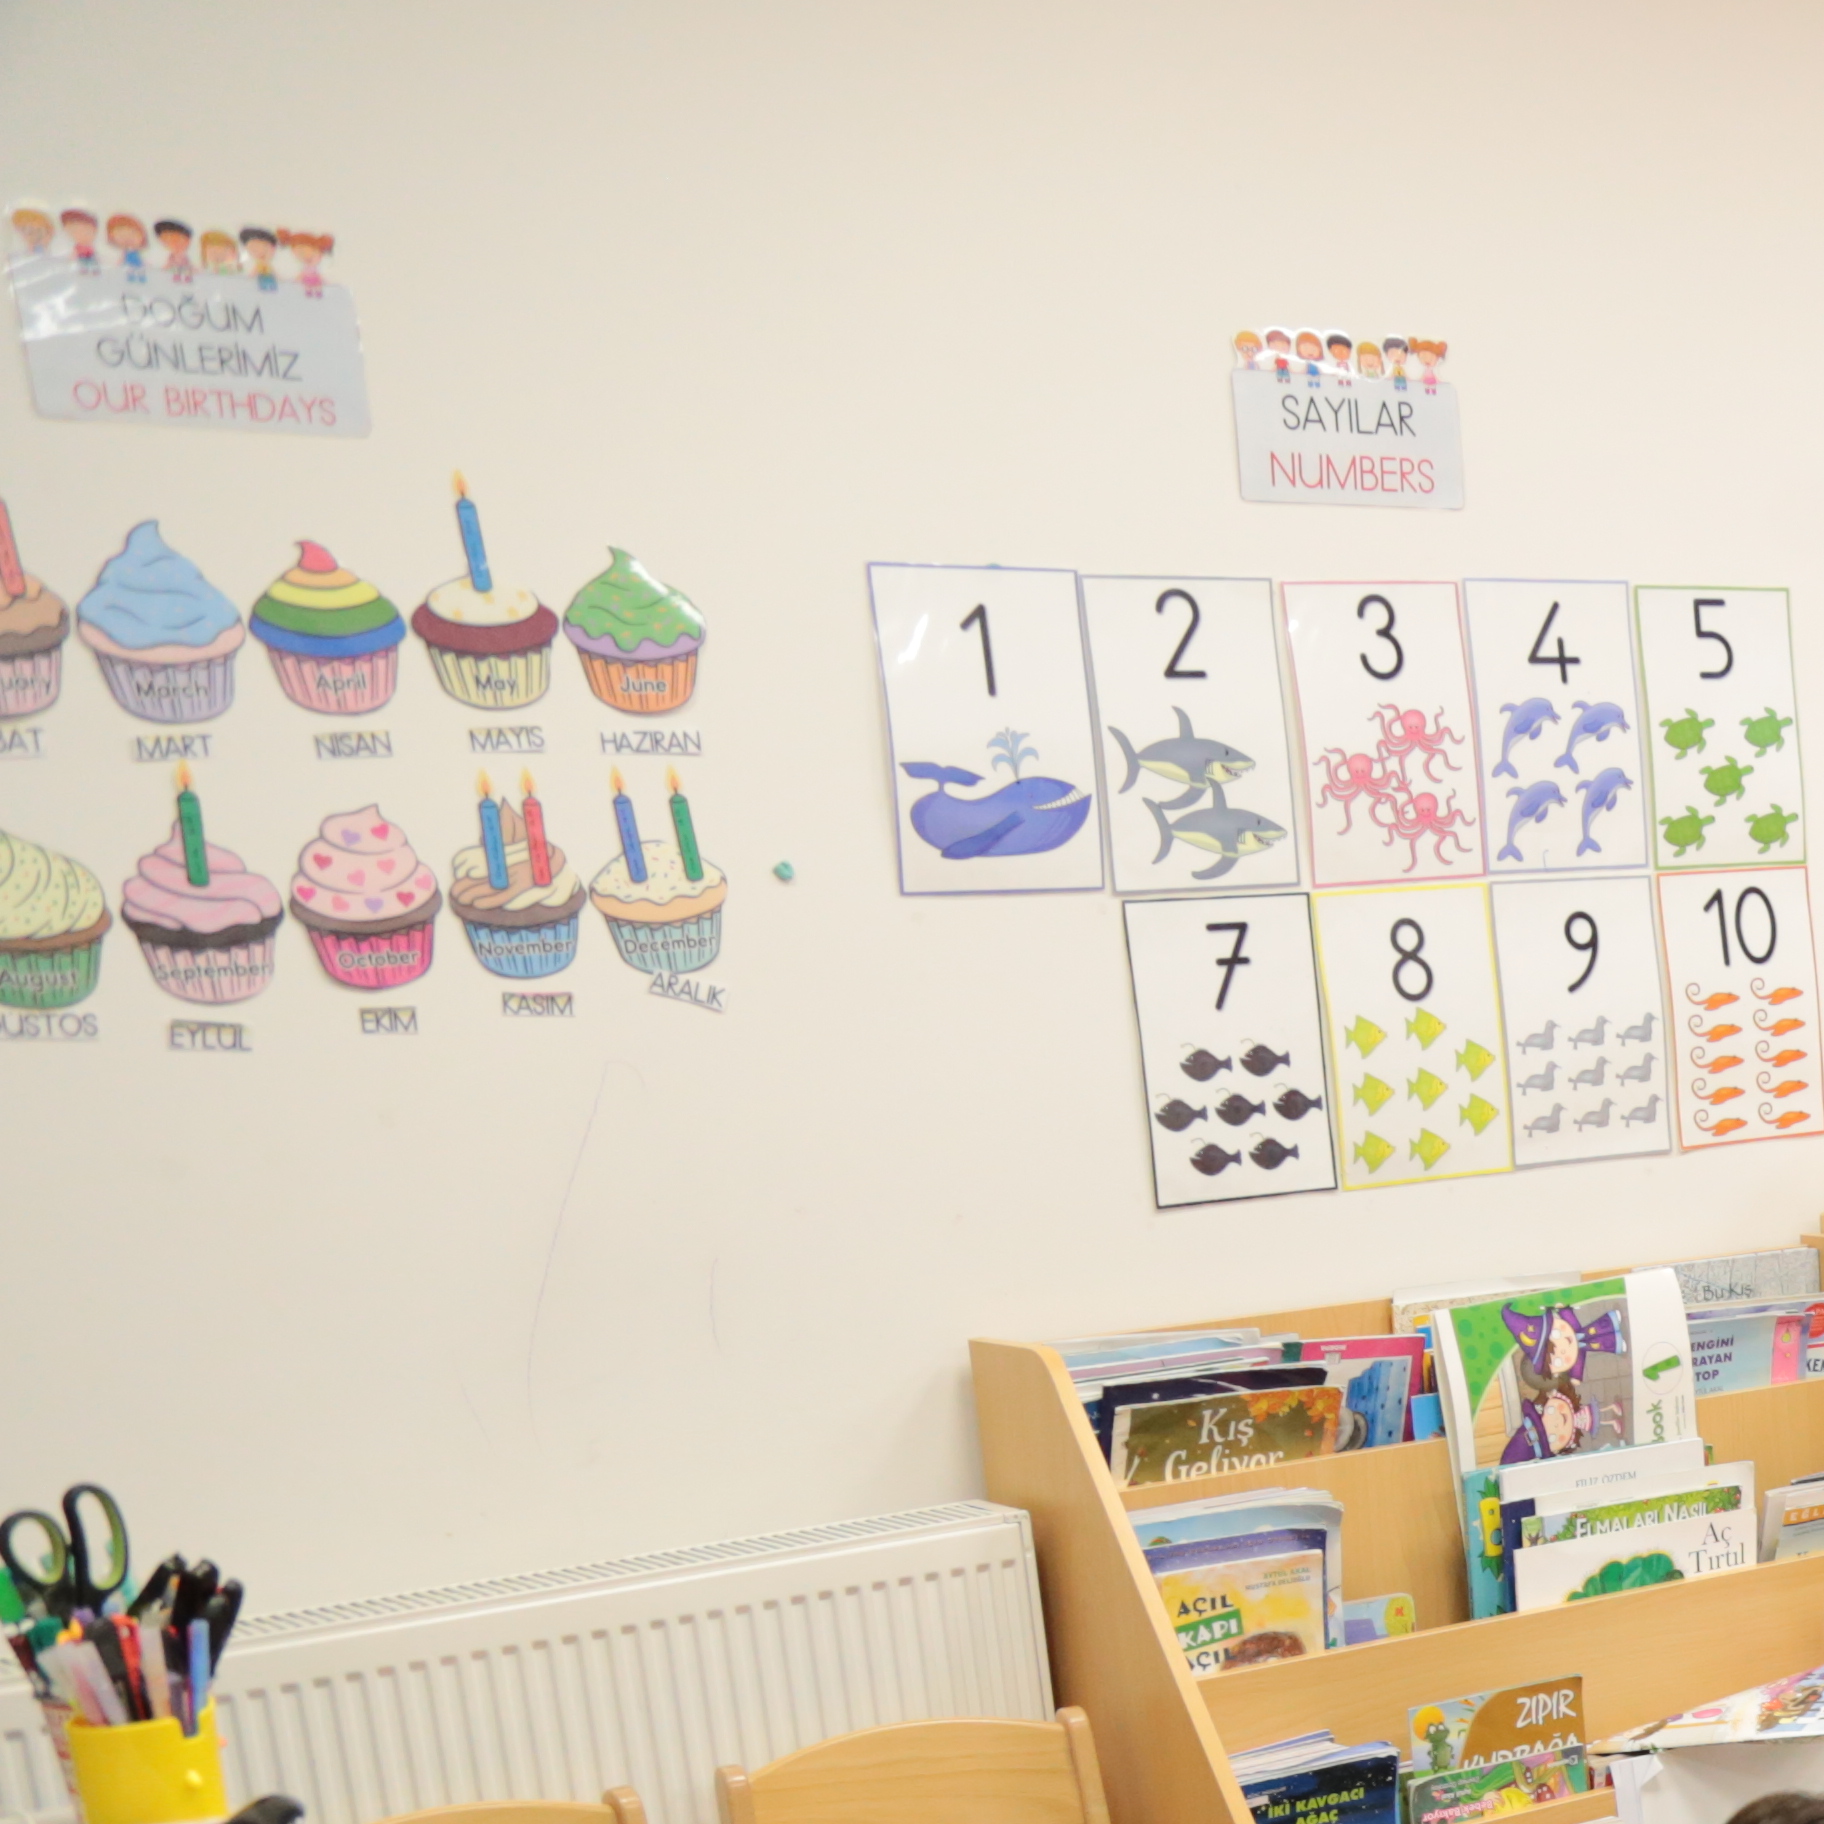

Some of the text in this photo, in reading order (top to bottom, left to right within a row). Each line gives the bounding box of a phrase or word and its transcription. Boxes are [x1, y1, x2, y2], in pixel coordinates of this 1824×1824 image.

[122, 293, 264, 334] DOĞUM
[97, 334, 303, 382] GÜNLERİMİZ
[73, 379, 337, 426] OUR BIRTHDAYS
[1281, 394, 1416, 437] SAYILAR
[1270, 451, 1435, 494] NUMBERS
[1154, 588, 1208, 681] 2
[1356, 594, 1404, 681] 3
[1527, 601, 1581, 685] 4
[1692, 598, 1735, 680] 5
[959, 604, 997, 697] 1
[136, 680, 208, 698] March
[315, 673, 367, 694] April
[475, 674, 516, 693] May
[620, 676, 667, 694] June
[136, 734, 213, 760] MART
[469, 726, 545, 751] MAYIS
[1703, 885, 1778, 968] 10
[478, 939, 573, 956] November
[624, 934, 717, 953] December
[1564, 911, 1599, 994] 9
[156, 961, 270, 984] September
[339, 950, 418, 968] October
[1205, 921, 1251, 1011] 7
[1391, 918, 1434, 1001] 8
[1, 968, 77, 991] August
[649, 971, 726, 1008] ARALIK
[502, 992, 575, 1016] KASIM
[0, 1012, 98, 1038] USTOS
[1691, 1335, 1734, 1352] ENGİNİ
[1642, 1354, 1682, 1382] 1
[1692, 1352, 1733, 1367] RAYAN
[1695, 1370, 1719, 1382] TOP
[1199, 1408, 1254, 1447] Kış
[1702, 1521, 1732, 1548] Aç
[1689, 1542, 1746, 1574] Tırtıl
[1177, 1594, 1234, 1617] AÇIL
[1178, 1618, 1239, 1648] KAPI
[1516, 1689, 1577, 1729] ZIPIR
[1268, 1801, 1290, 1819] İKİ
[1296, 1787, 1365, 1812] KAVGACI
